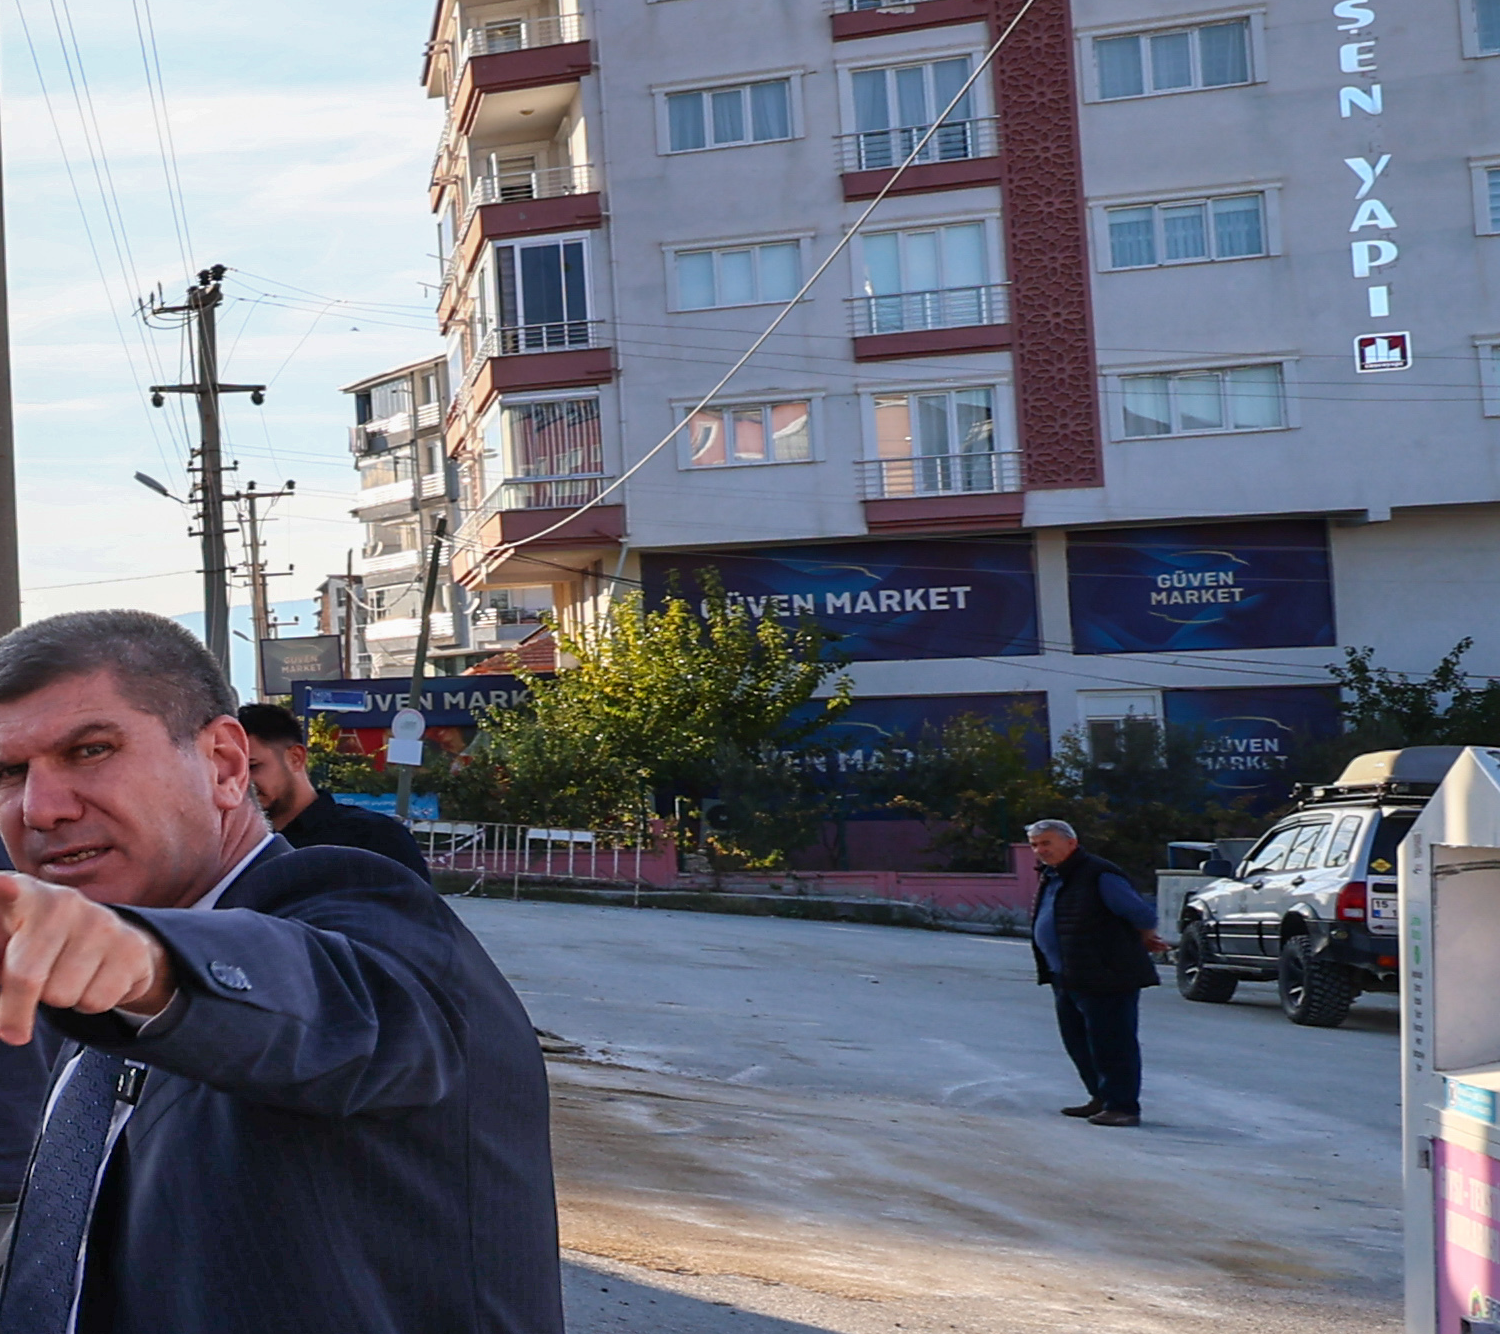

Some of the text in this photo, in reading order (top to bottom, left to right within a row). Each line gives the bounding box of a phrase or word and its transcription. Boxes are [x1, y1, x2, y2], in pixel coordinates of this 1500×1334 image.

[1344, 154, 1398, 318] YAPI
[1157, 570, 1234, 588] GÜVEN
[826, 585, 971, 615] MARKET
[1150, 588, 1244, 605] MARKET
